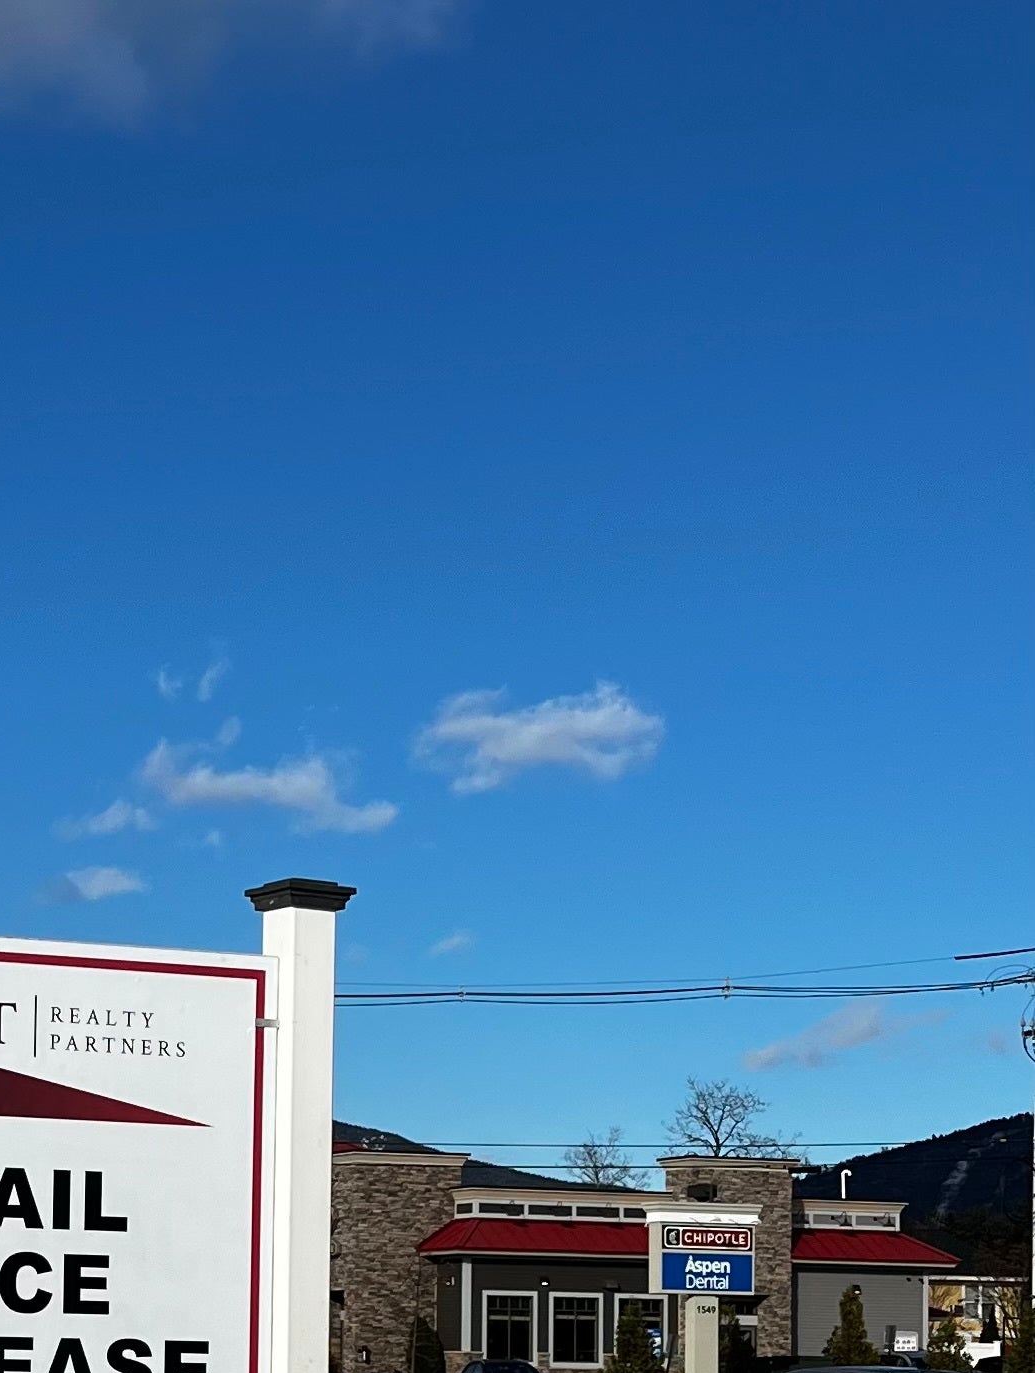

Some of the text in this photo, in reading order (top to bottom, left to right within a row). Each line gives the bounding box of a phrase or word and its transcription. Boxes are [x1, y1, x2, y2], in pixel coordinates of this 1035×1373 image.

[50, 1005, 155, 1029] REALTY
[50, 1033, 187, 1058] PARTNERS
[684, 1232, 746, 1244] CHIPOTLE
[685, 1255, 731, 1275] Aspen
[685, 1274, 729, 1289] Dental
[696, 1305, 716, 1314] 1549
